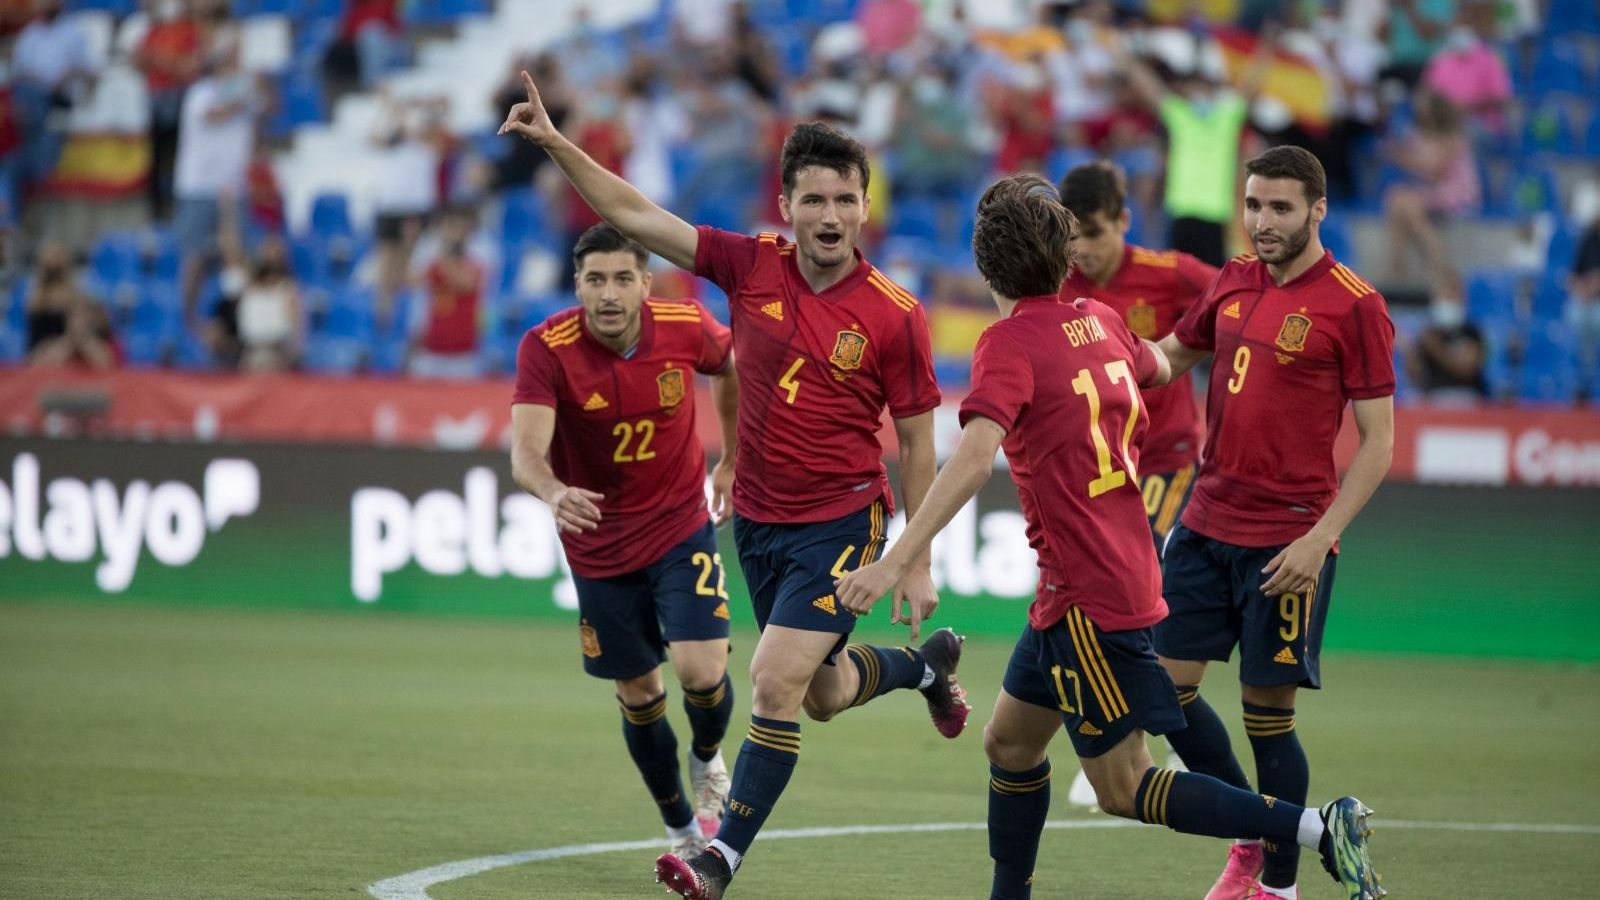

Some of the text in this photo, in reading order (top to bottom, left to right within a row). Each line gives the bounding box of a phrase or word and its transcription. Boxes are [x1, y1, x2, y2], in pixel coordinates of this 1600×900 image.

[1061, 314, 1108, 347] BRYAN
[779, 357, 805, 404] 4
[1228, 346, 1251, 394] 9
[613, 419, 656, 463] 22
[1071, 359, 1140, 498] 17
[1279, 592, 1300, 642] 9
[1051, 664, 1084, 717] 17
